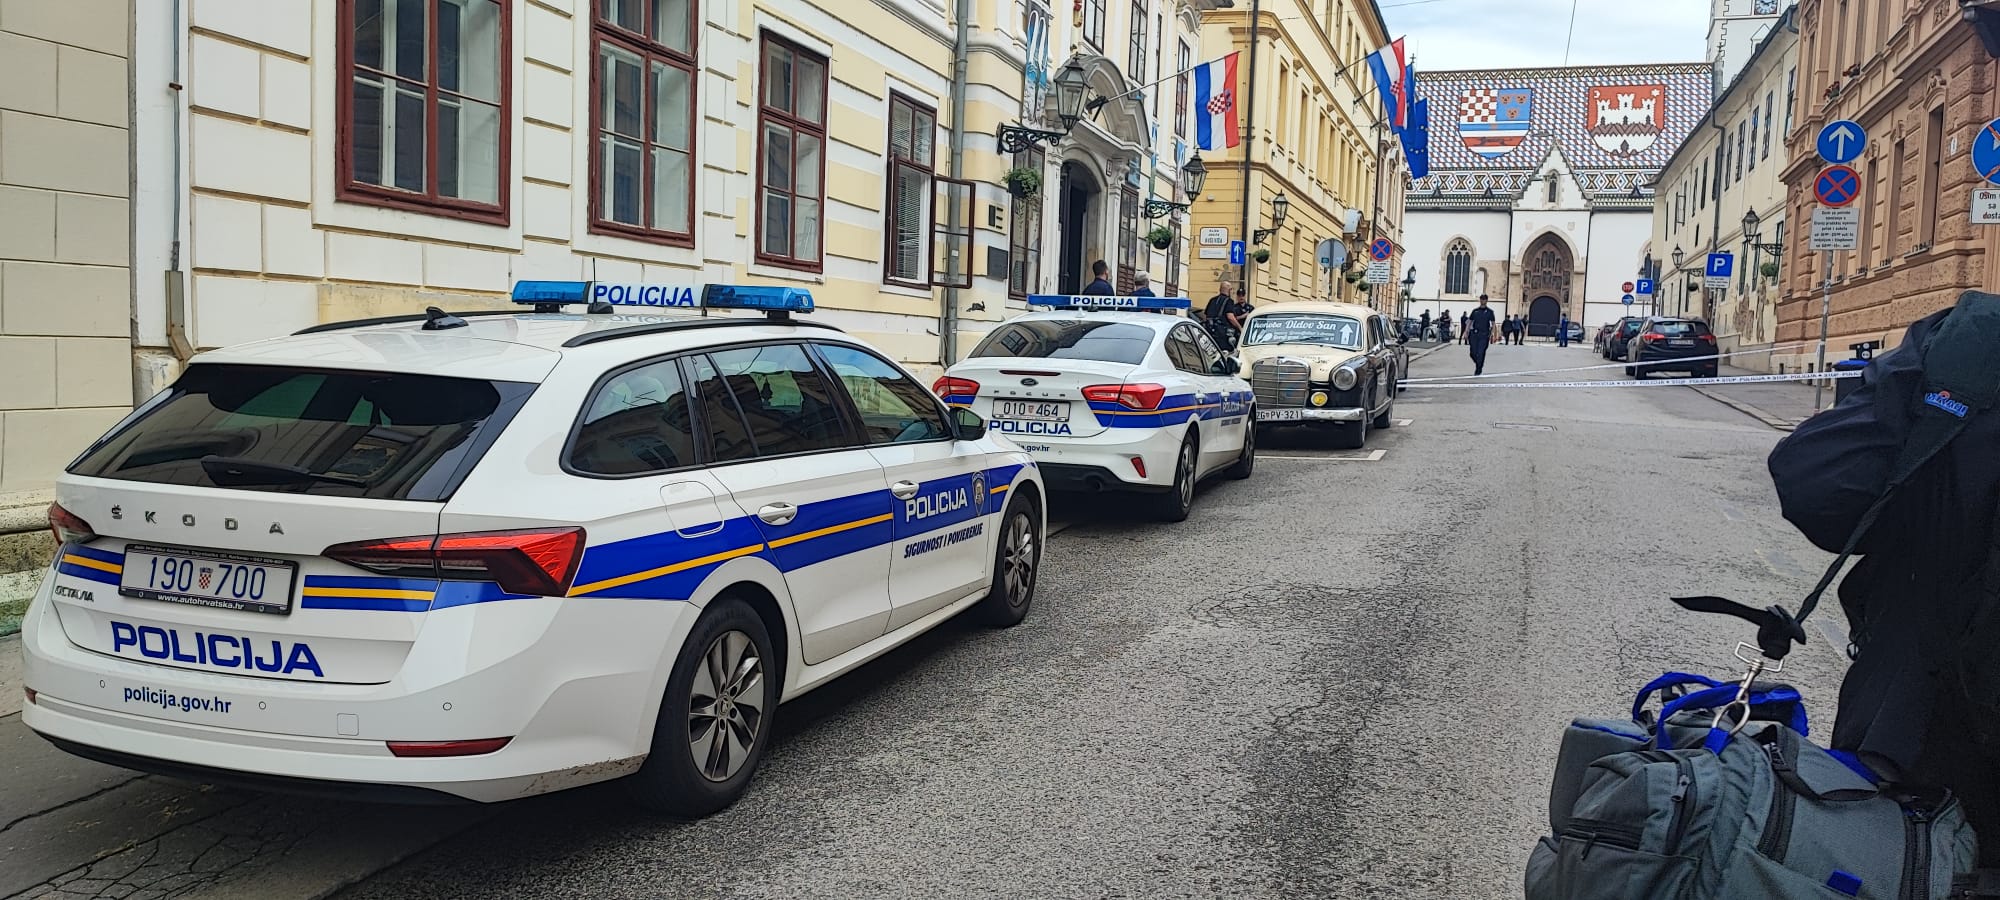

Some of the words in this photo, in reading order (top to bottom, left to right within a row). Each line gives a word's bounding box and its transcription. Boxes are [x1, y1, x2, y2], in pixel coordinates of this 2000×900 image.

[1979, 191, 1997, 200] Osim
[1713, 257, 1726, 273] P
[1640, 281, 1649, 292] P
[594, 285, 695, 307] POLICIJA
[1072, 296, 1136, 306] POLICIJA
[1285, 320, 1315, 329] Didov
[1316, 320, 1337, 330] San
[1003, 401, 1026, 415] 010
[1036, 403, 1059, 417] 464
[1270, 409, 1299, 420] PV-321
[988, 420, 1072, 435] POLICIJA
[905, 487, 968, 523] POLICIJA
[903, 534, 944, 559] SIGURNOST
[947, 522, 984, 547] POVJERENJE
[149, 556, 194, 593] 190
[214, 563, 267, 601] 700
[55, 585, 95, 603] OCTAVIA
[157, 593, 245, 611] www.autohrvatska.hr
[110, 620, 325, 678] POLICIJA
[123, 684, 232, 714] policija.gov.hr
